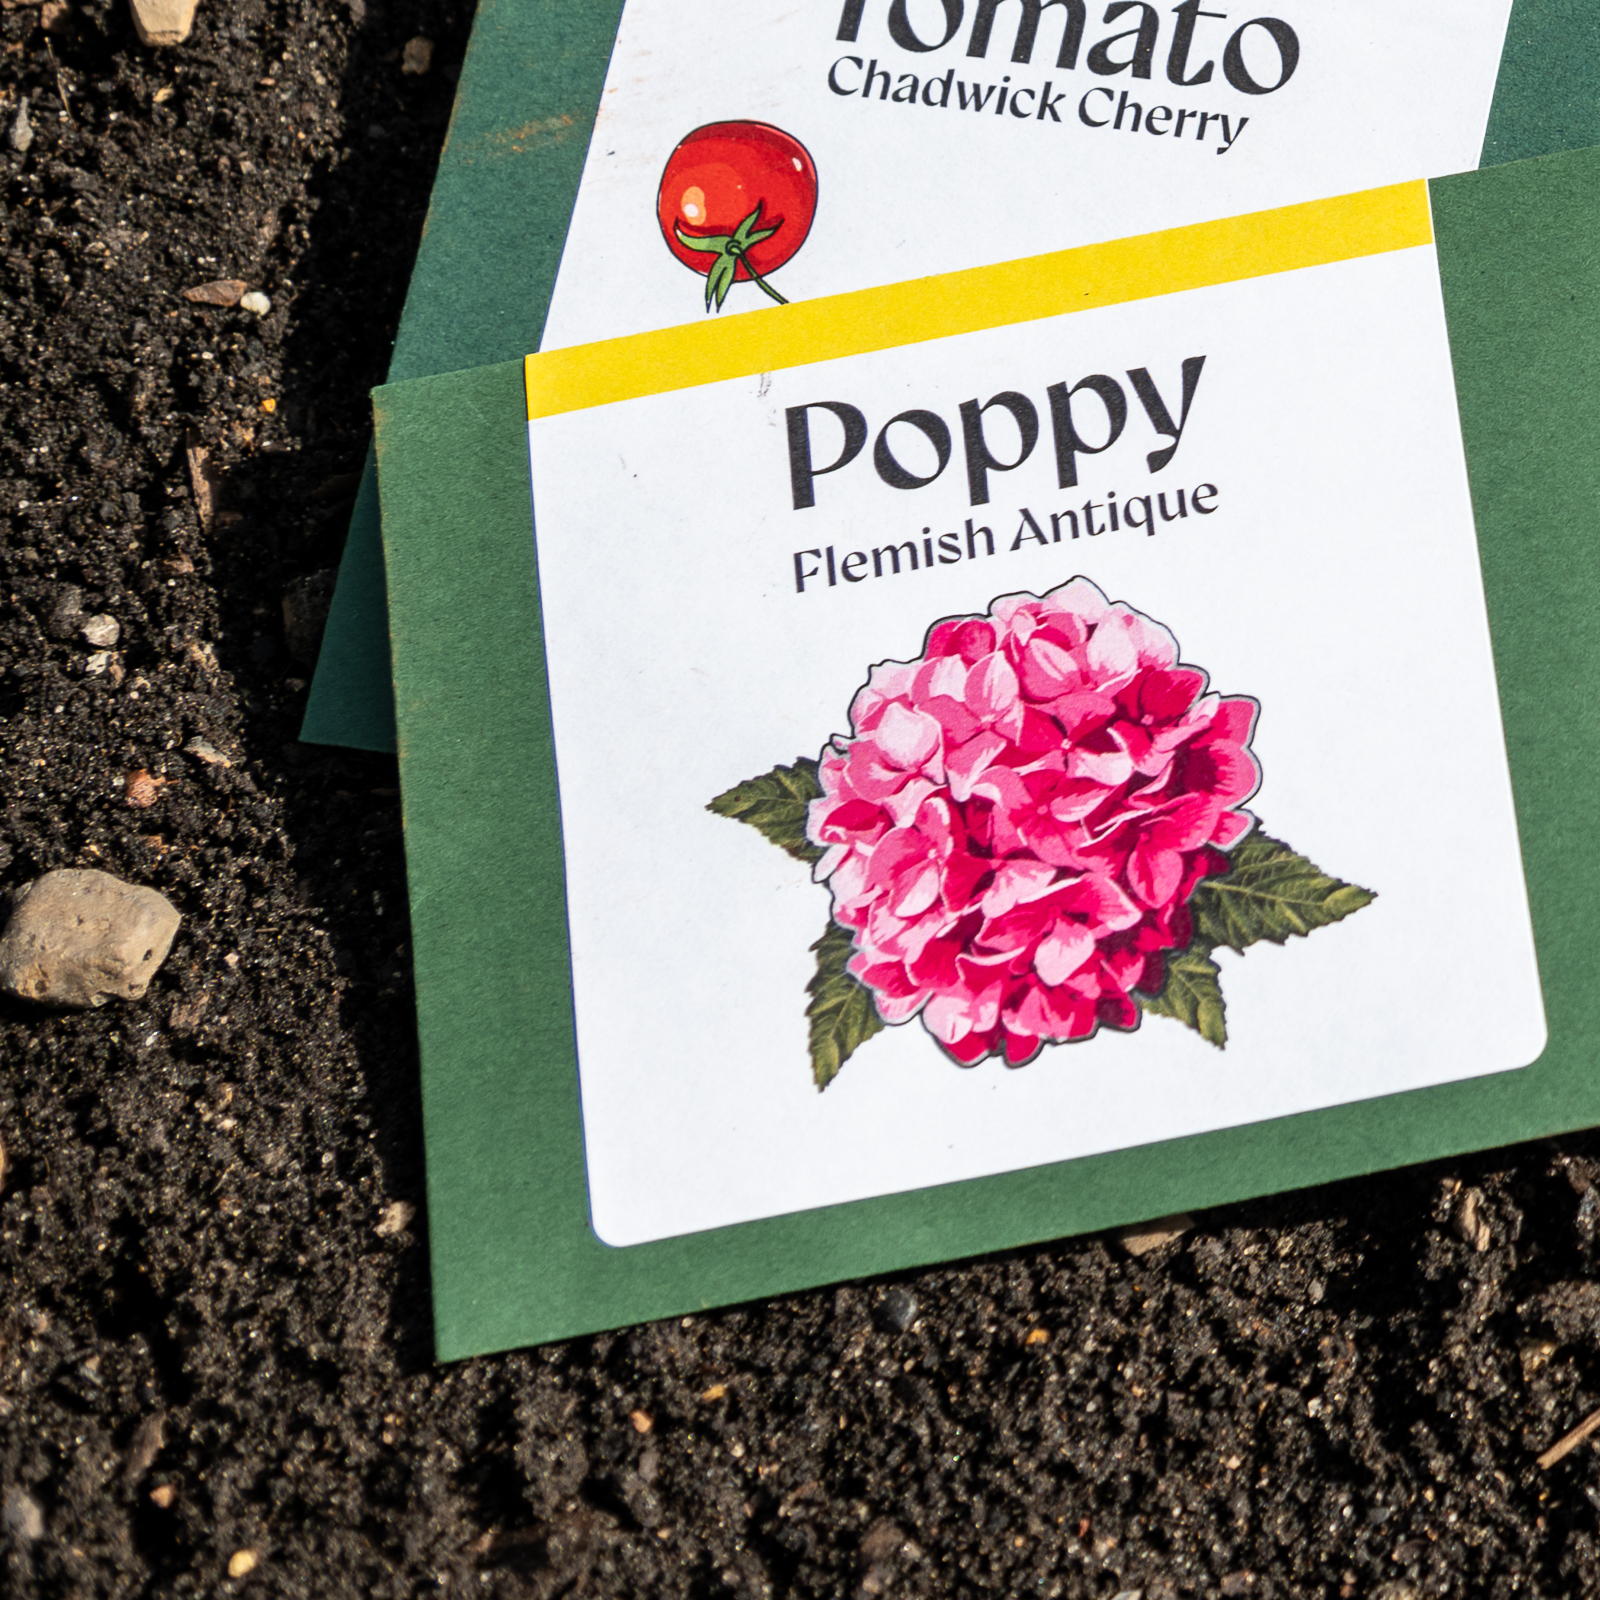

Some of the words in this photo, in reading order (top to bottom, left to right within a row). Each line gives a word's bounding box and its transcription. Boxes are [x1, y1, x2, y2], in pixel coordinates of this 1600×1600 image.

[826, 55, 1066, 123] Chadwick
[1077, 86, 1249, 155] Cherry
[785, 355, 1206, 511] Poppy
[792, 519, 996, 594] Flemish
[1009, 482, 1219, 552] Antique
